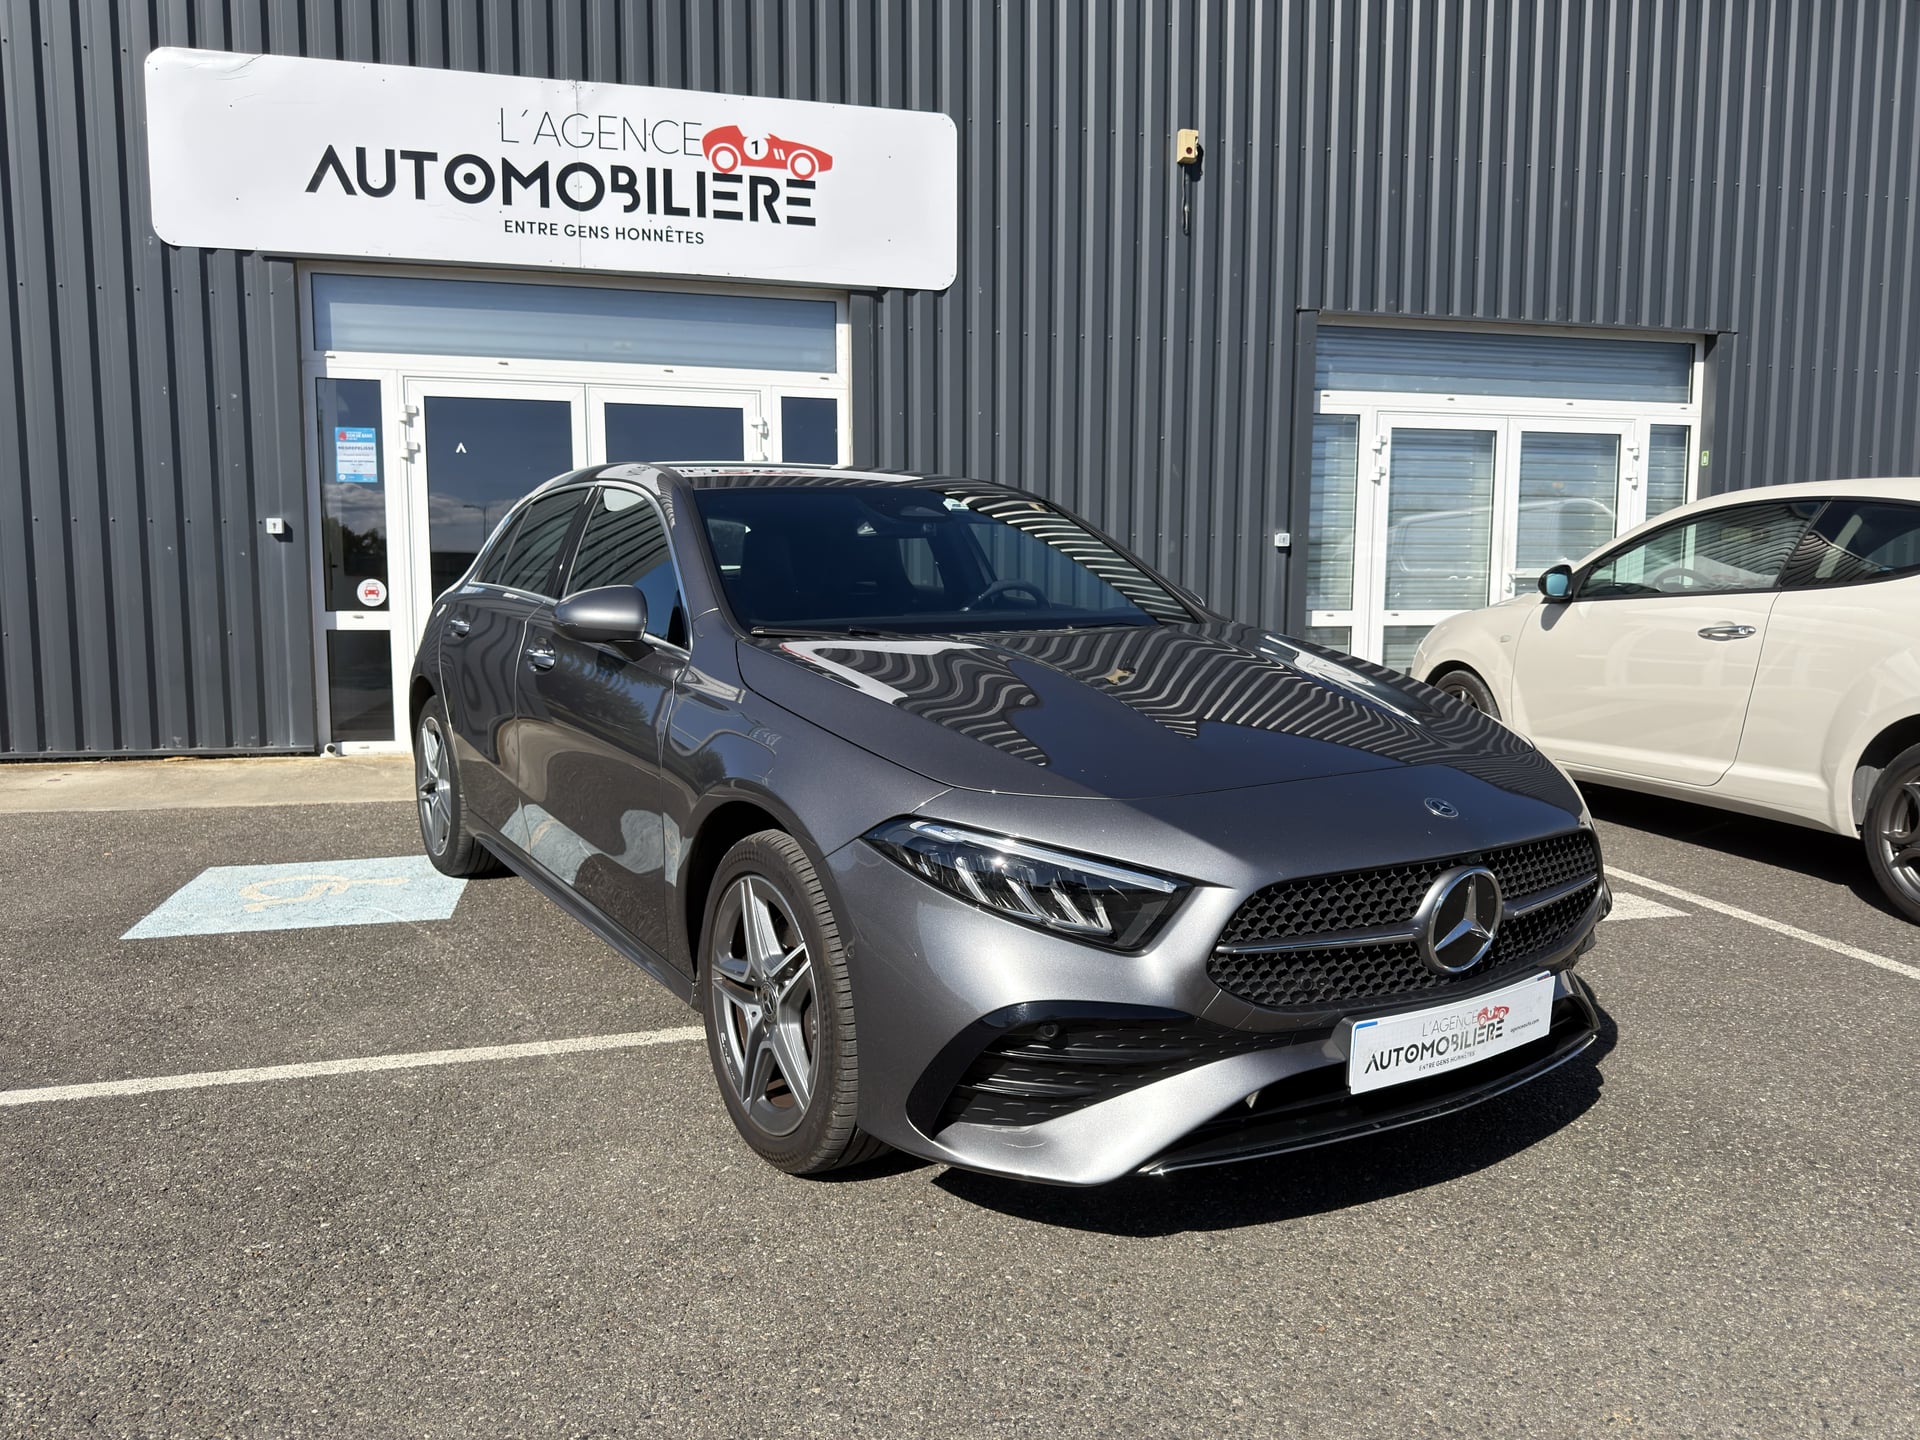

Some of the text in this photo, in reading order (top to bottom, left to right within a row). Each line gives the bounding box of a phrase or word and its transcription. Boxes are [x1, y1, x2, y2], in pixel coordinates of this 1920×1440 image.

[750, 139, 759, 155] 1
[504, 219, 704, 245] ENTRE GENS HONNÊTES
[1418, 1061, 1435, 1072] ENTRE
[1435, 1057, 1450, 1067] GENS
